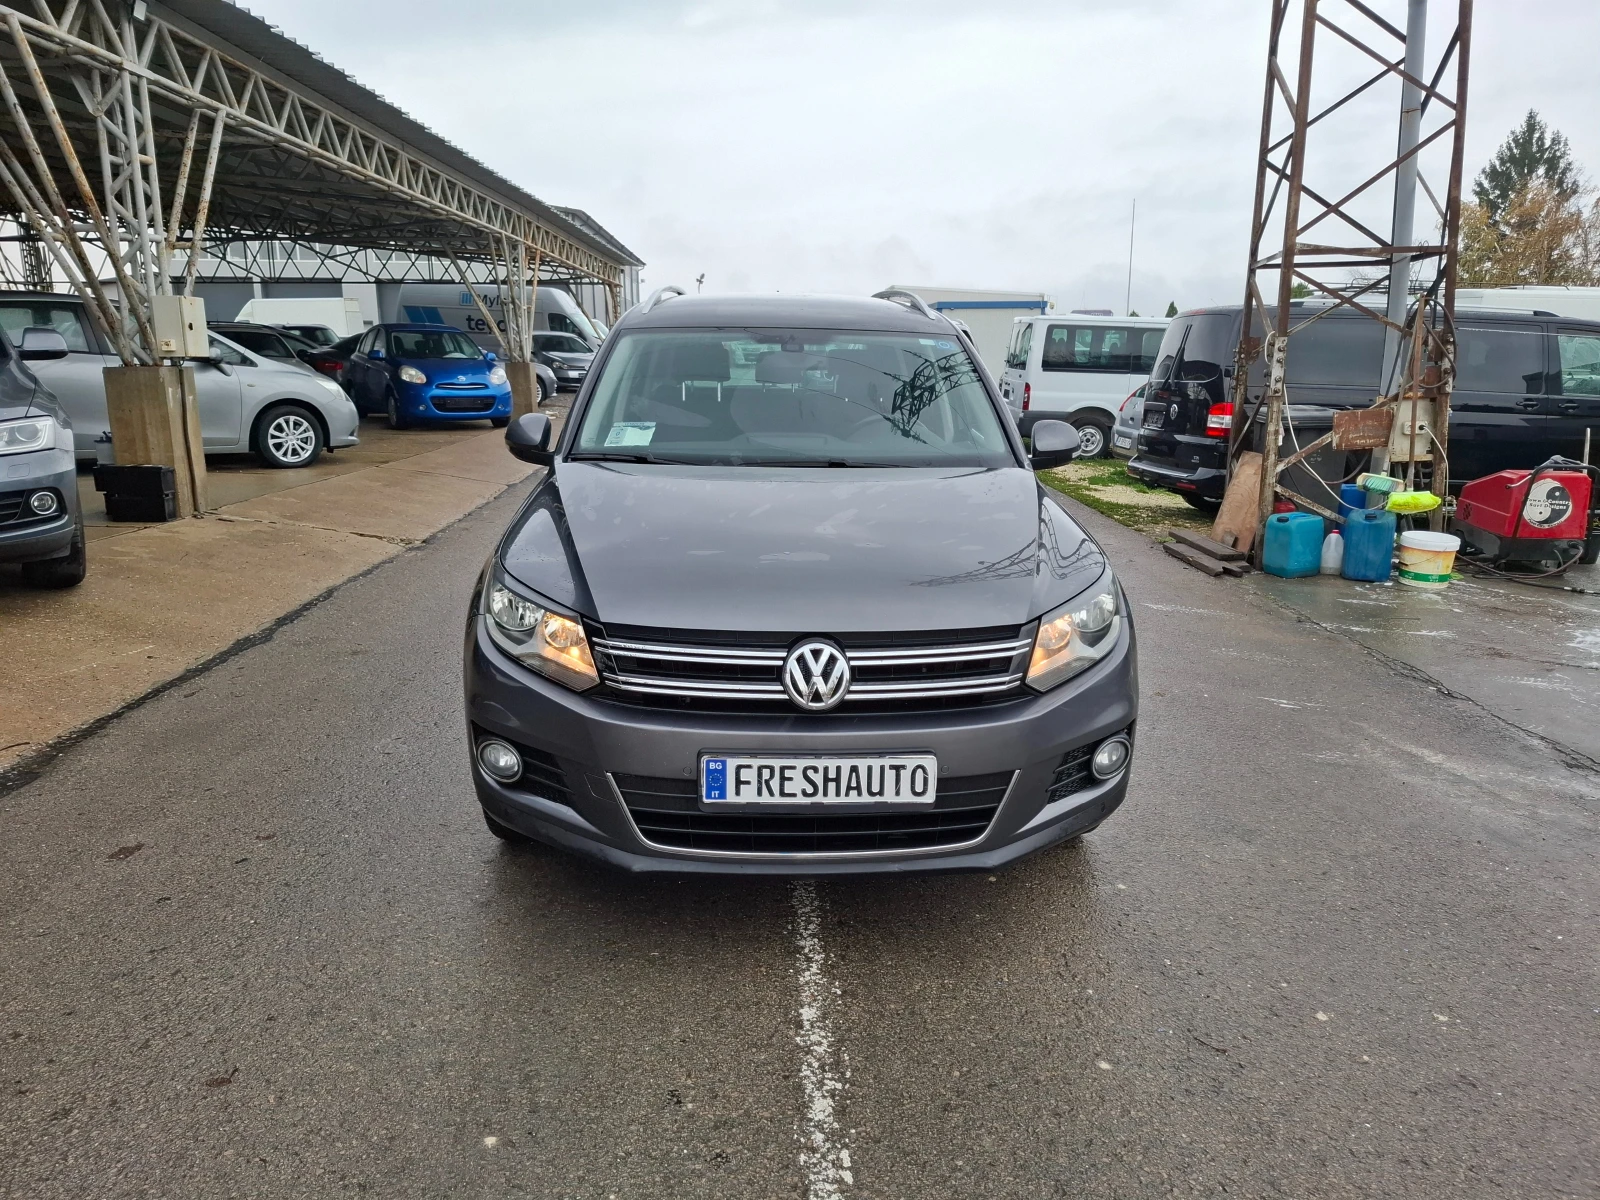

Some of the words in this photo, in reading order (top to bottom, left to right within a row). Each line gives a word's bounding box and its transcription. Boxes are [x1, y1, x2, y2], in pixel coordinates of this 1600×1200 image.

[709, 762, 722, 770] BG
[734, 763, 929, 798] FRESHAUTO
[711, 790, 720, 798] IT
